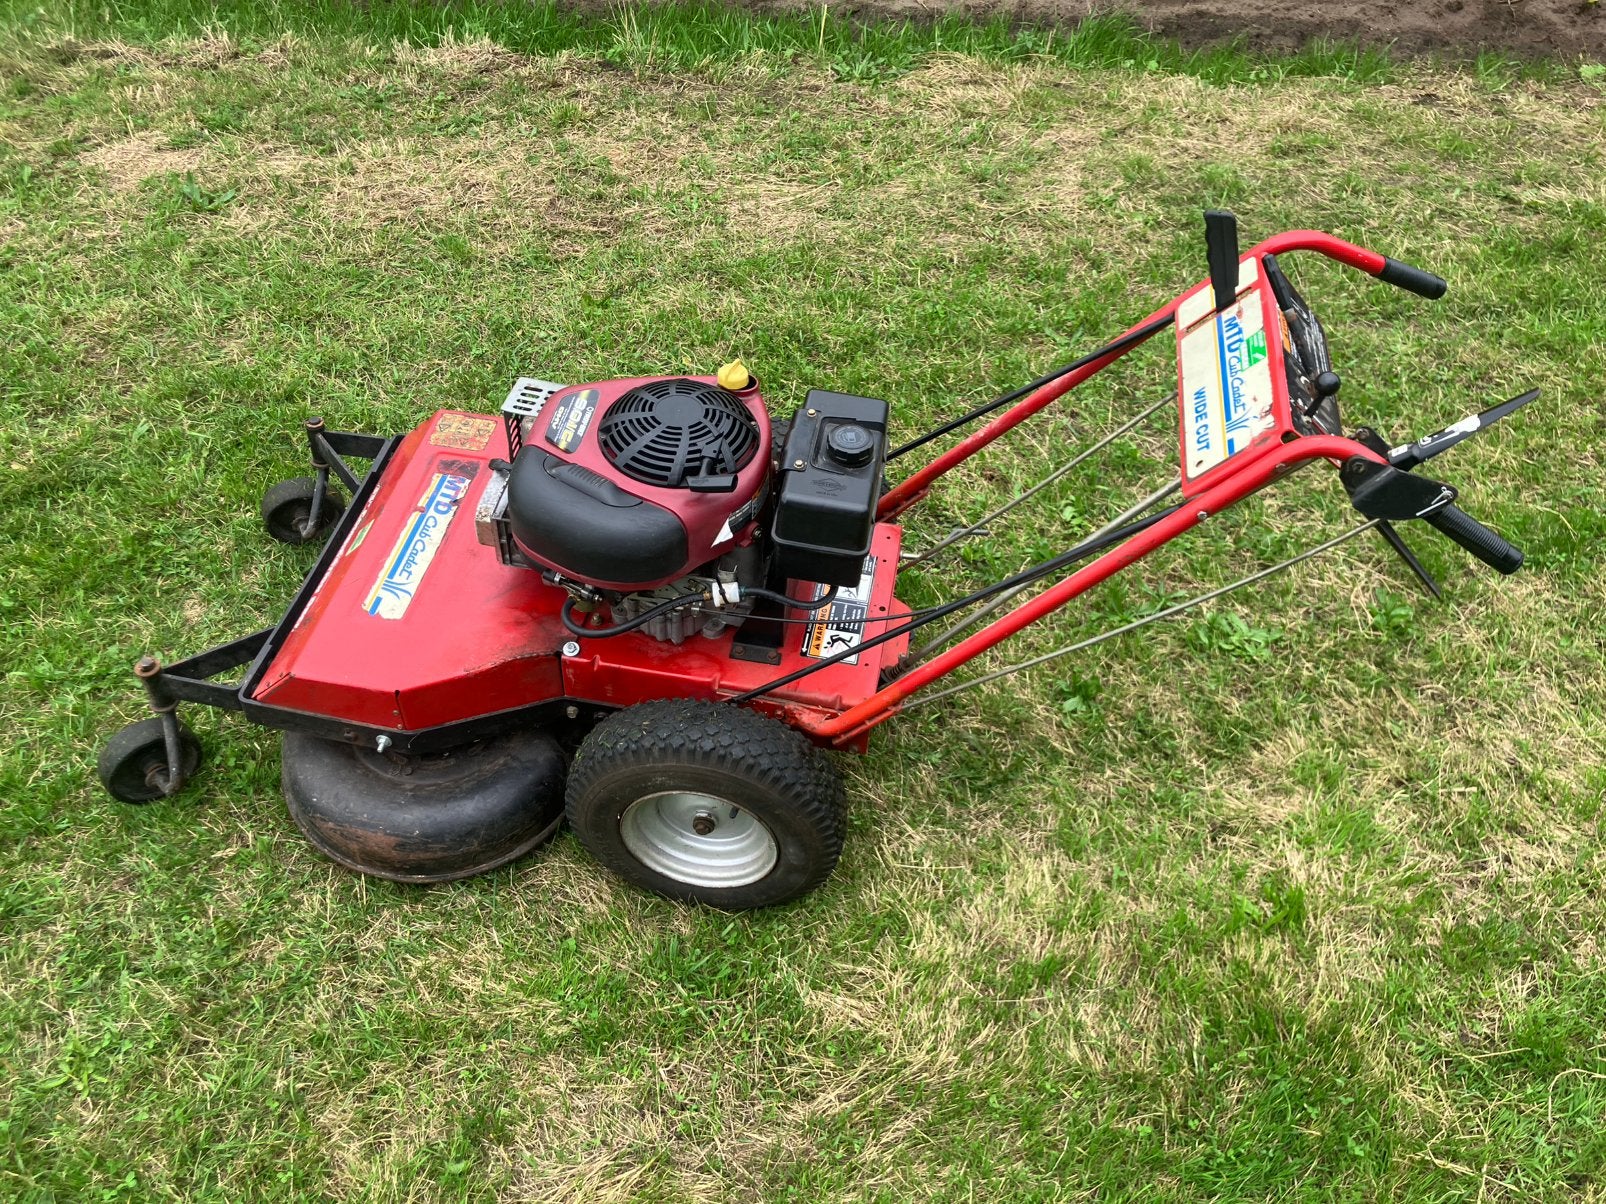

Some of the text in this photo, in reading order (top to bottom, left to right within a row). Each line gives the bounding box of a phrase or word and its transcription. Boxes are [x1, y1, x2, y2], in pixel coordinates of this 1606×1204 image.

[1224, 316, 1246, 413] MTD Cub Cadet
[1193, 386, 1210, 451] WIDE CUT
[398, 476, 466, 580] MTD Cub Cadet
